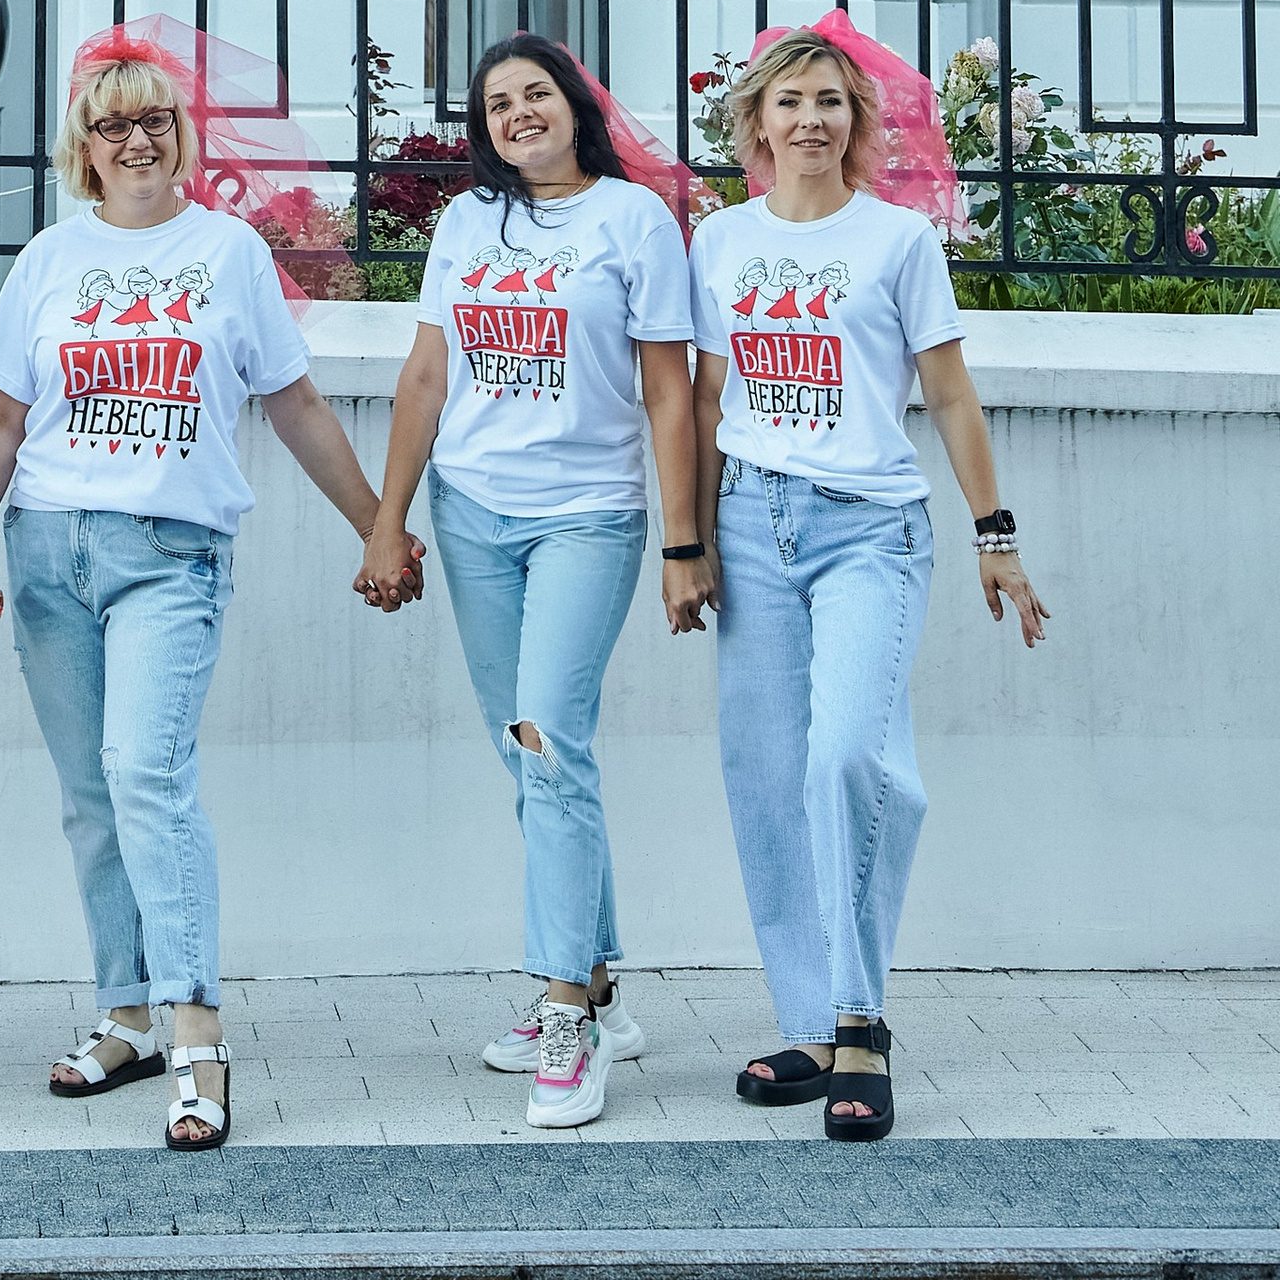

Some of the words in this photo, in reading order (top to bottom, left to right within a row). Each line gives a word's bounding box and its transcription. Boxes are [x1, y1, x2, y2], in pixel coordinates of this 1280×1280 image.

[456, 308, 564, 354] БАНДА
[64, 342, 199, 397] БАНДА
[465, 350, 566, 390] НЕВЕСТЫ
[735, 335, 840, 382] БАНДА
[66, 396, 201, 443] НЕВЕСТЫ
[744, 378, 844, 418] НЕВЕСТЫ
